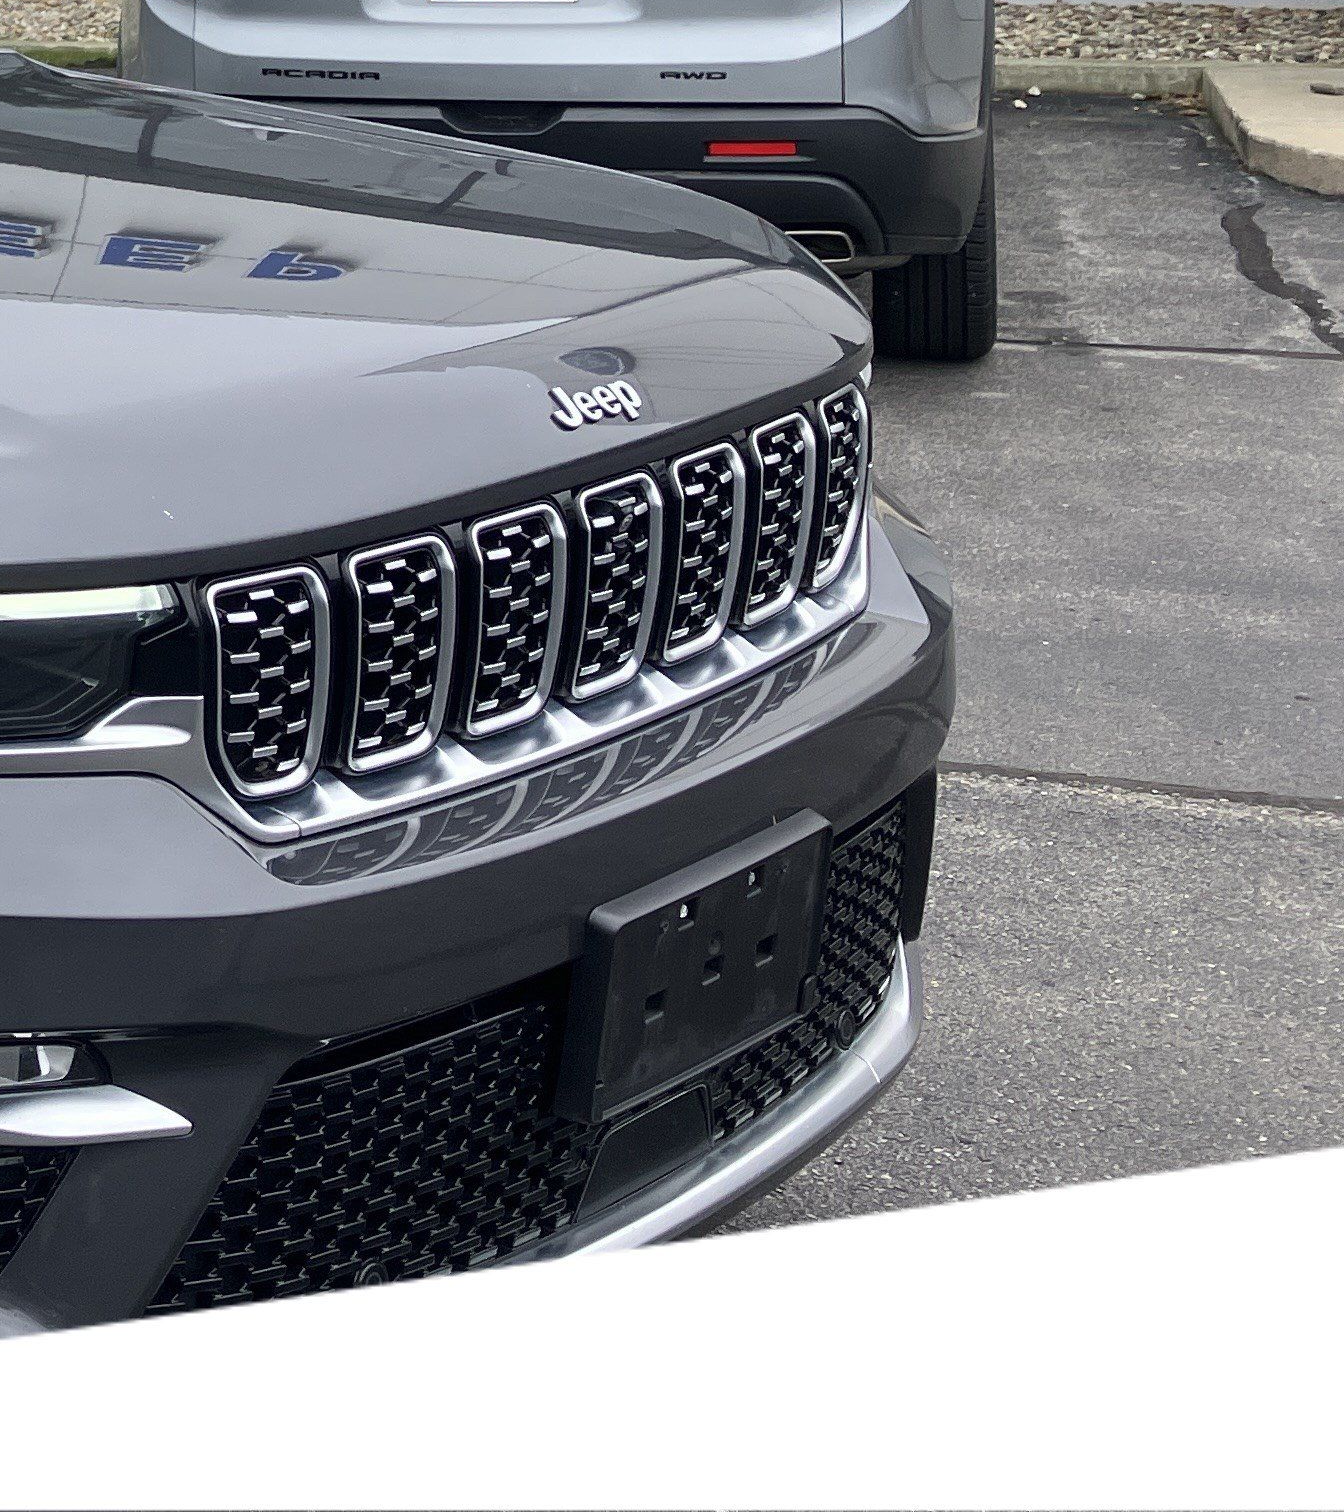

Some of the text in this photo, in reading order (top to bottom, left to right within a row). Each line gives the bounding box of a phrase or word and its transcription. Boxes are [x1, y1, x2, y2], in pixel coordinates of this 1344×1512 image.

[261, 67, 381, 80] ACADIA
[659, 70, 728, 80] AWD
[547, 379, 643, 432] Jeep
